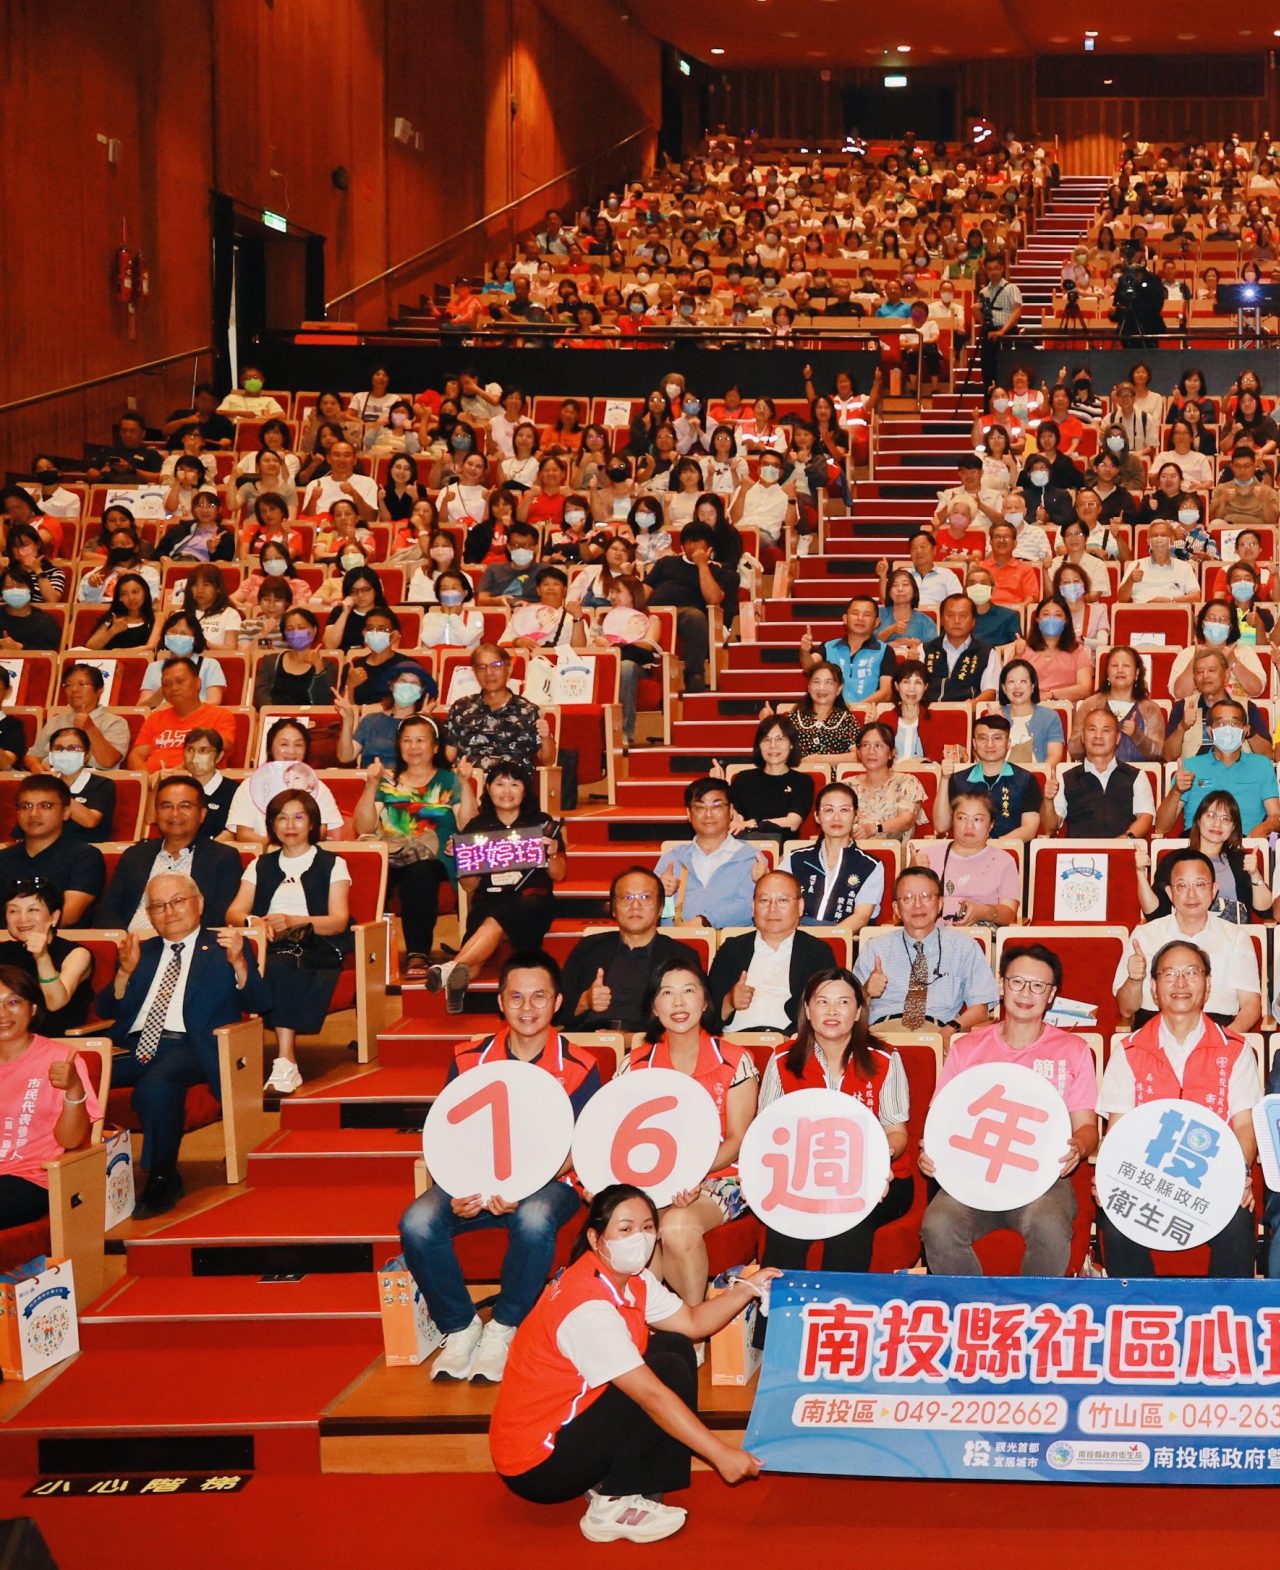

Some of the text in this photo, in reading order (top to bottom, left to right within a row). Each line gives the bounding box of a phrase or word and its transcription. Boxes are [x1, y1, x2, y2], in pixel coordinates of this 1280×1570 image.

[447, 1080, 512, 1181] 1
[610, 1096, 678, 1187] 6
[949, 1083, 1049, 1183] 年
[761, 1116, 866, 1214] 週
[1117, 1161, 1211, 1215] 南投縣政府
[1106, 1187, 1194, 1246] 衛生局
[800, 1399, 1058, 1427] 南投區 049-2202662
[1087, 1402, 1164, 1429] 竹山區
[993, 1456, 1039, 1469] 宜居城市
[995, 1441, 1040, 1454] 觀光首都
[1078, 1449, 1143, 1460] 南投縣政府衛生局
[32, 1476, 242, 1495] 小心階梯
